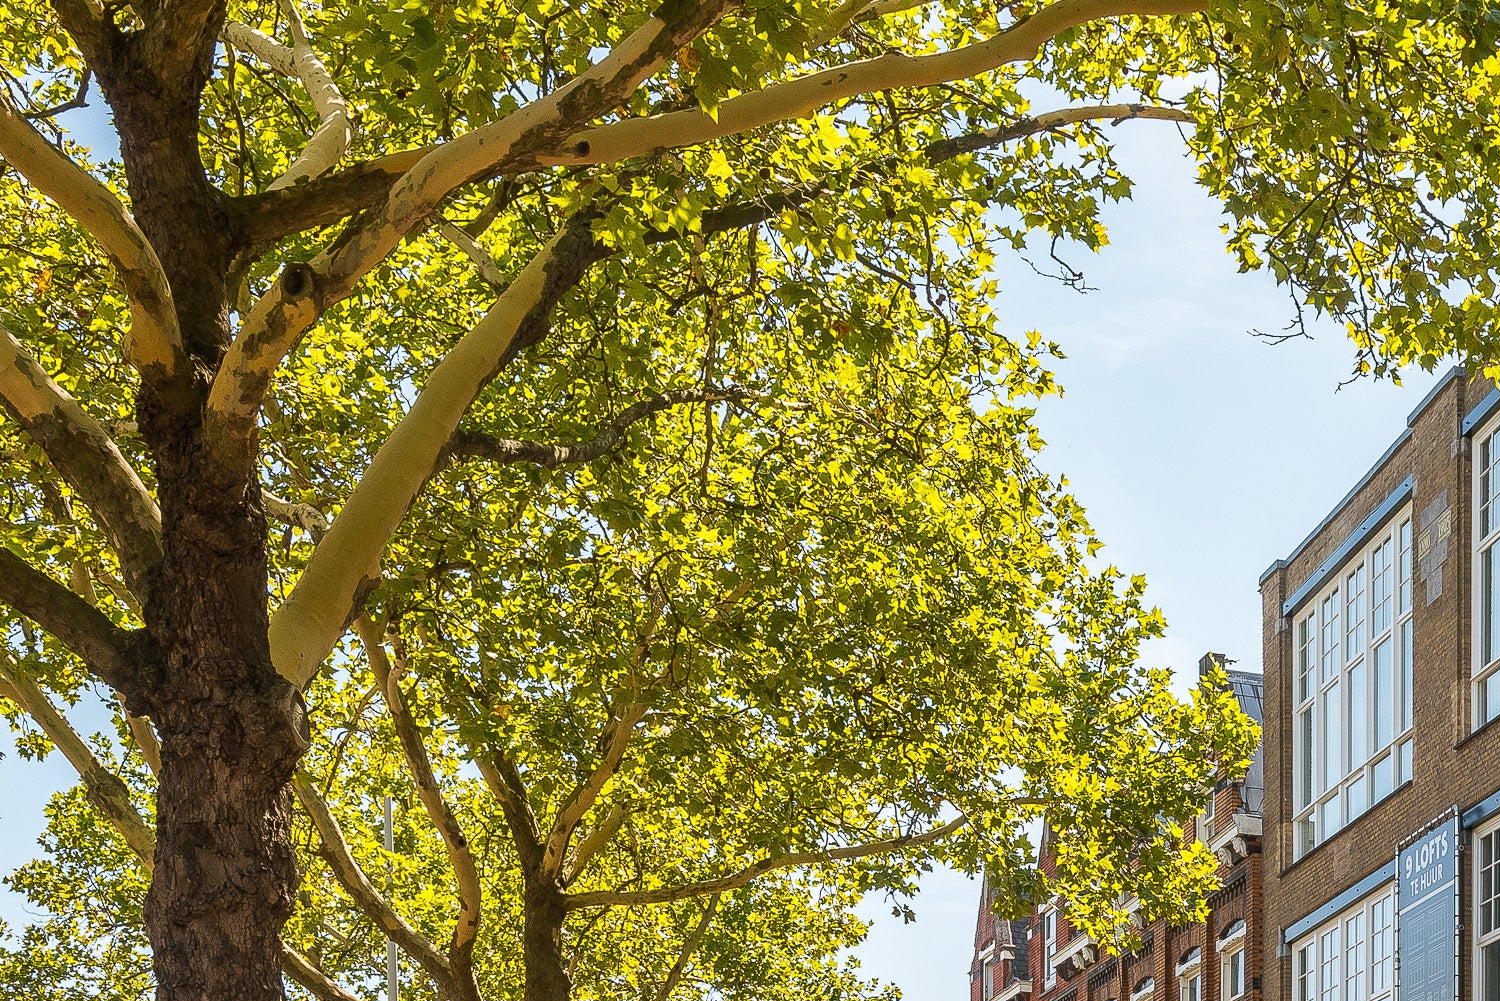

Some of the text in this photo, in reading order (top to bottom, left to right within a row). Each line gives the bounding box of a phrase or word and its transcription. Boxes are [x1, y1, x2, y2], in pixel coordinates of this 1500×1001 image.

[1405, 830, 1448, 880] 9 LOFTS
[1410, 863, 1443, 897] TE HUUR
